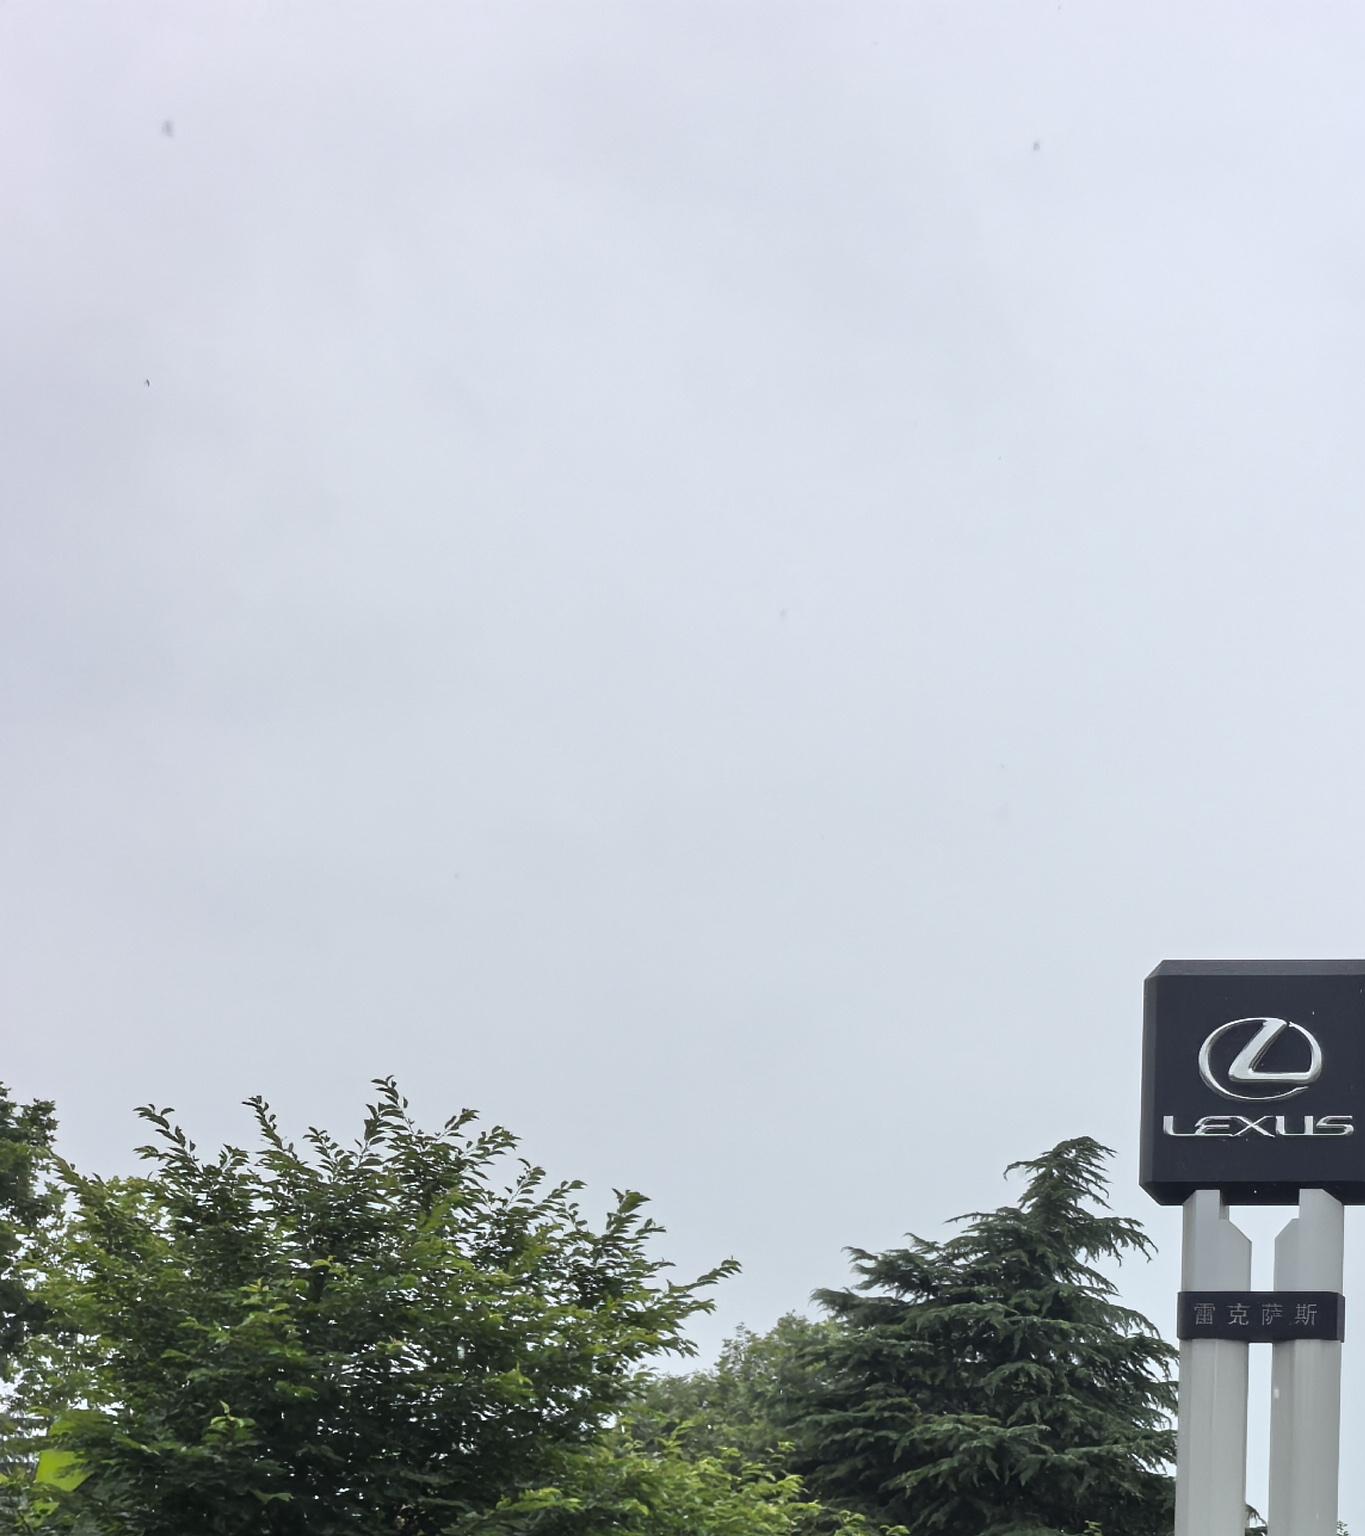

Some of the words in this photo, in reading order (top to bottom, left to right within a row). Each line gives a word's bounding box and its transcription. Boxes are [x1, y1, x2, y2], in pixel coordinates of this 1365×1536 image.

[1162, 1115, 1354, 1138] LEXUS
[1193, 1302, 1318, 1327] 雷克萨斯
